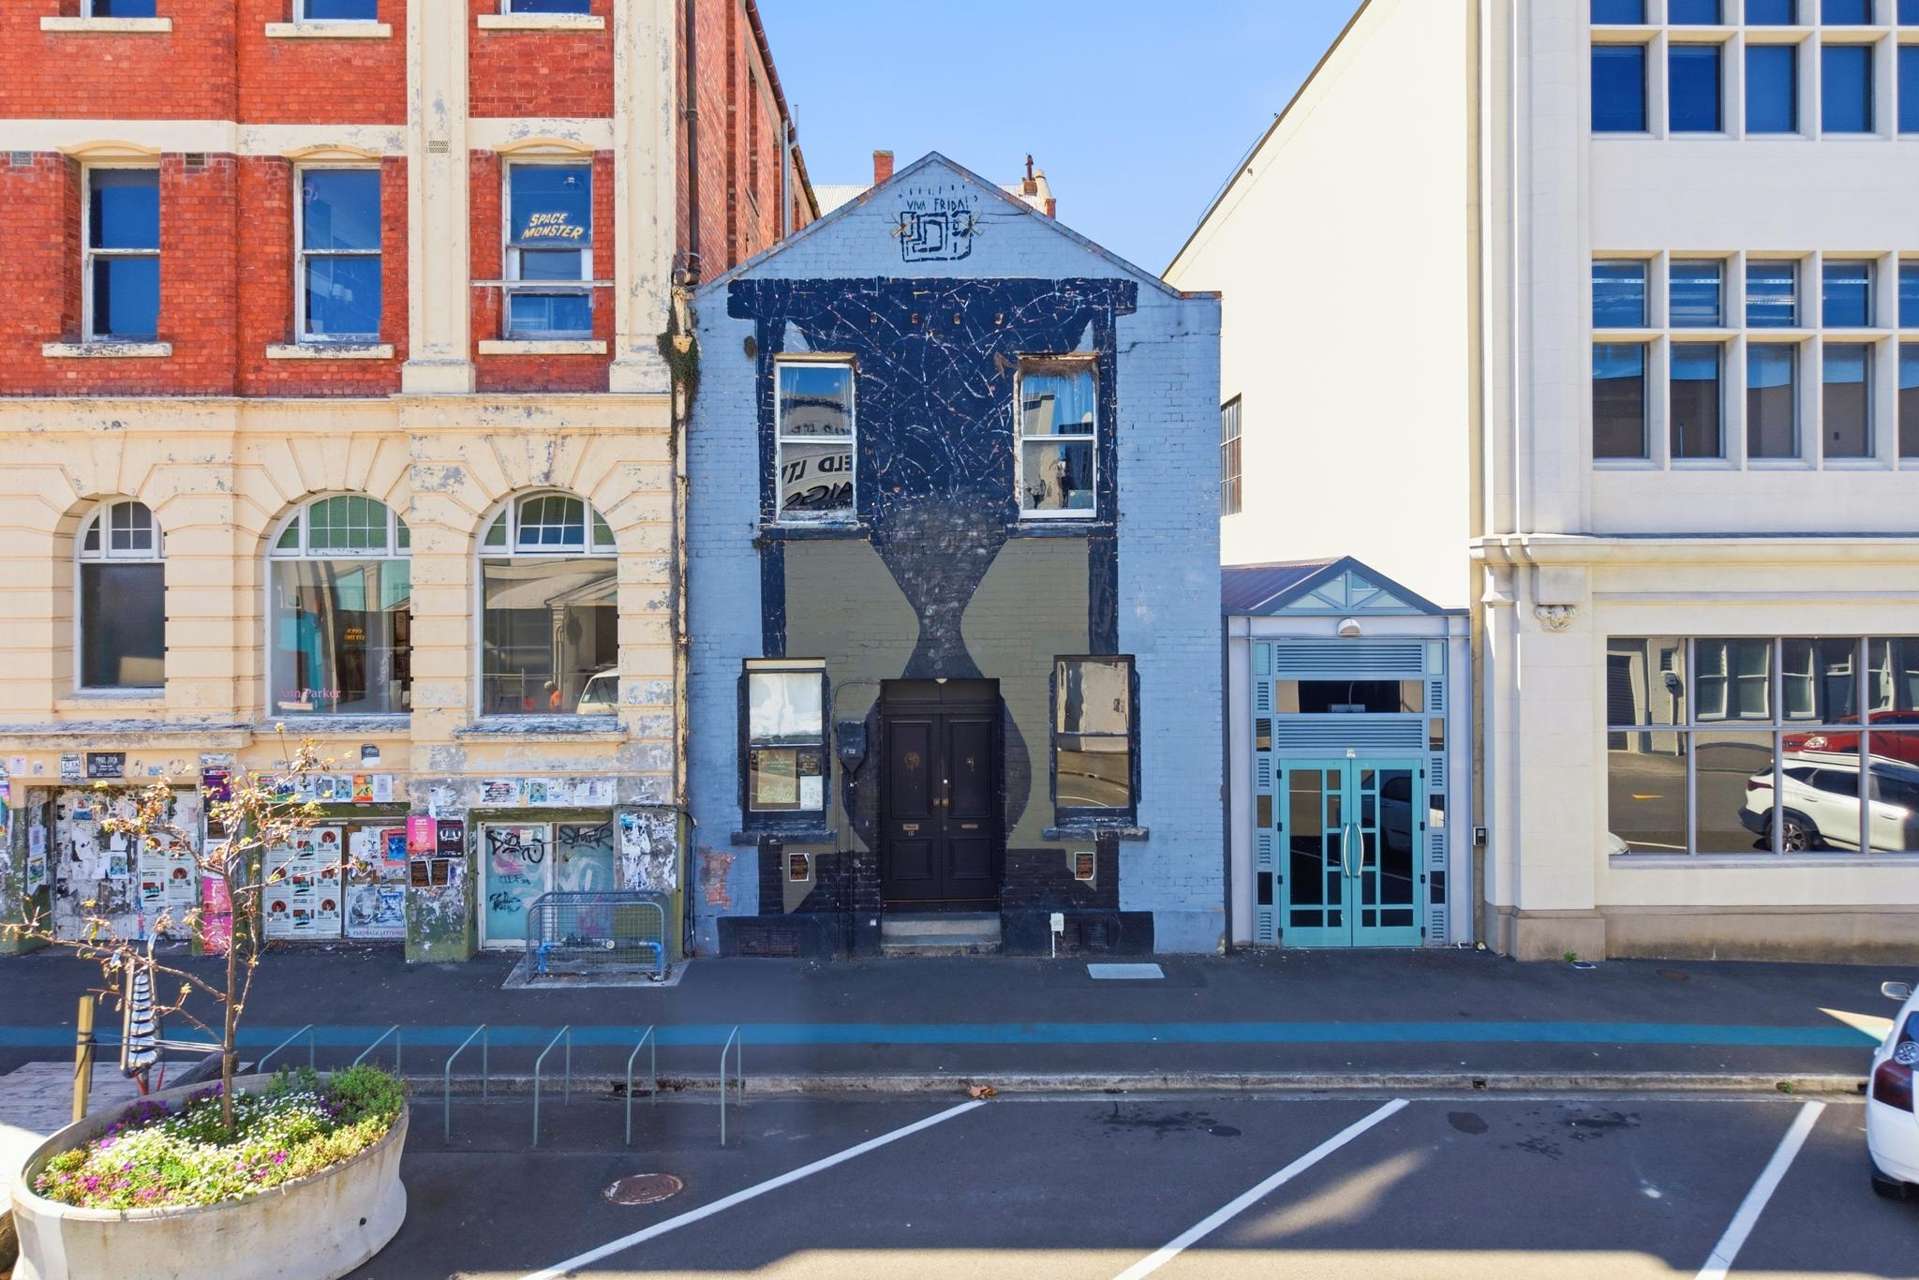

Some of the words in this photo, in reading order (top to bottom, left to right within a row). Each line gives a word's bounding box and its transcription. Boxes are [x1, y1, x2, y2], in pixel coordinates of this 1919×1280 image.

[907, 199, 926, 210] VIVA
[529, 212, 568, 227] SPACE
[521, 224, 584, 240] MONSTER
